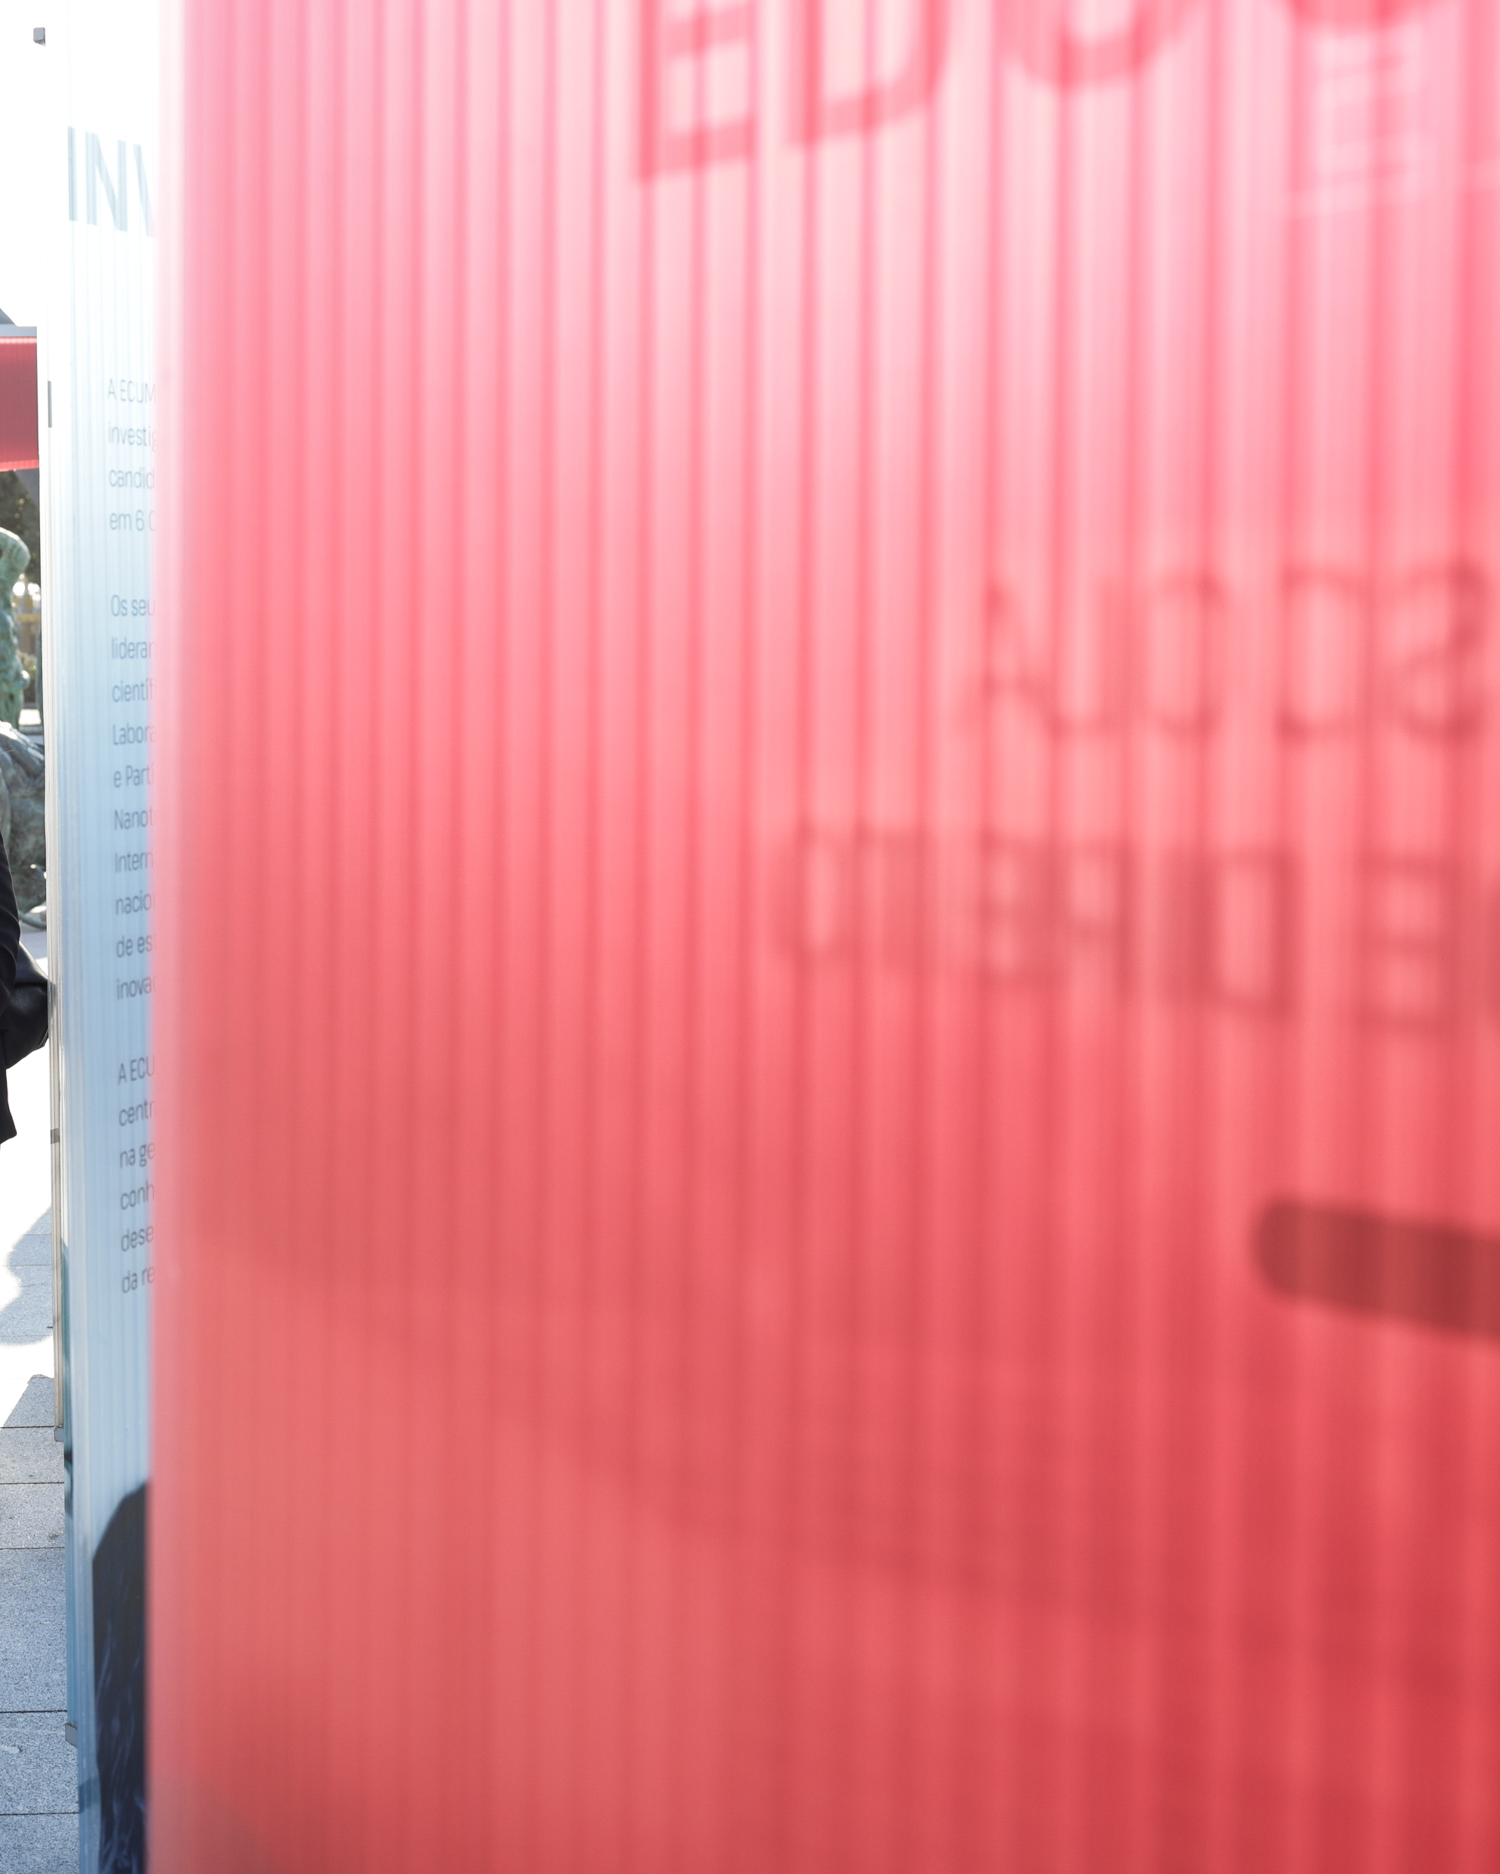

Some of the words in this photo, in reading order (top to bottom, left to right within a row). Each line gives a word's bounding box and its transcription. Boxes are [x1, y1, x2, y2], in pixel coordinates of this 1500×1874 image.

[109, 511, 132, 531] em
[135, 509, 145, 532] 6
[110, 594, 128, 617] Os
[113, 770, 122, 788] e
[115, 935, 133, 958] de
[117, 1062, 127, 1086] A
[119, 1147, 136, 1169] na
[121, 1270, 139, 1294] da
